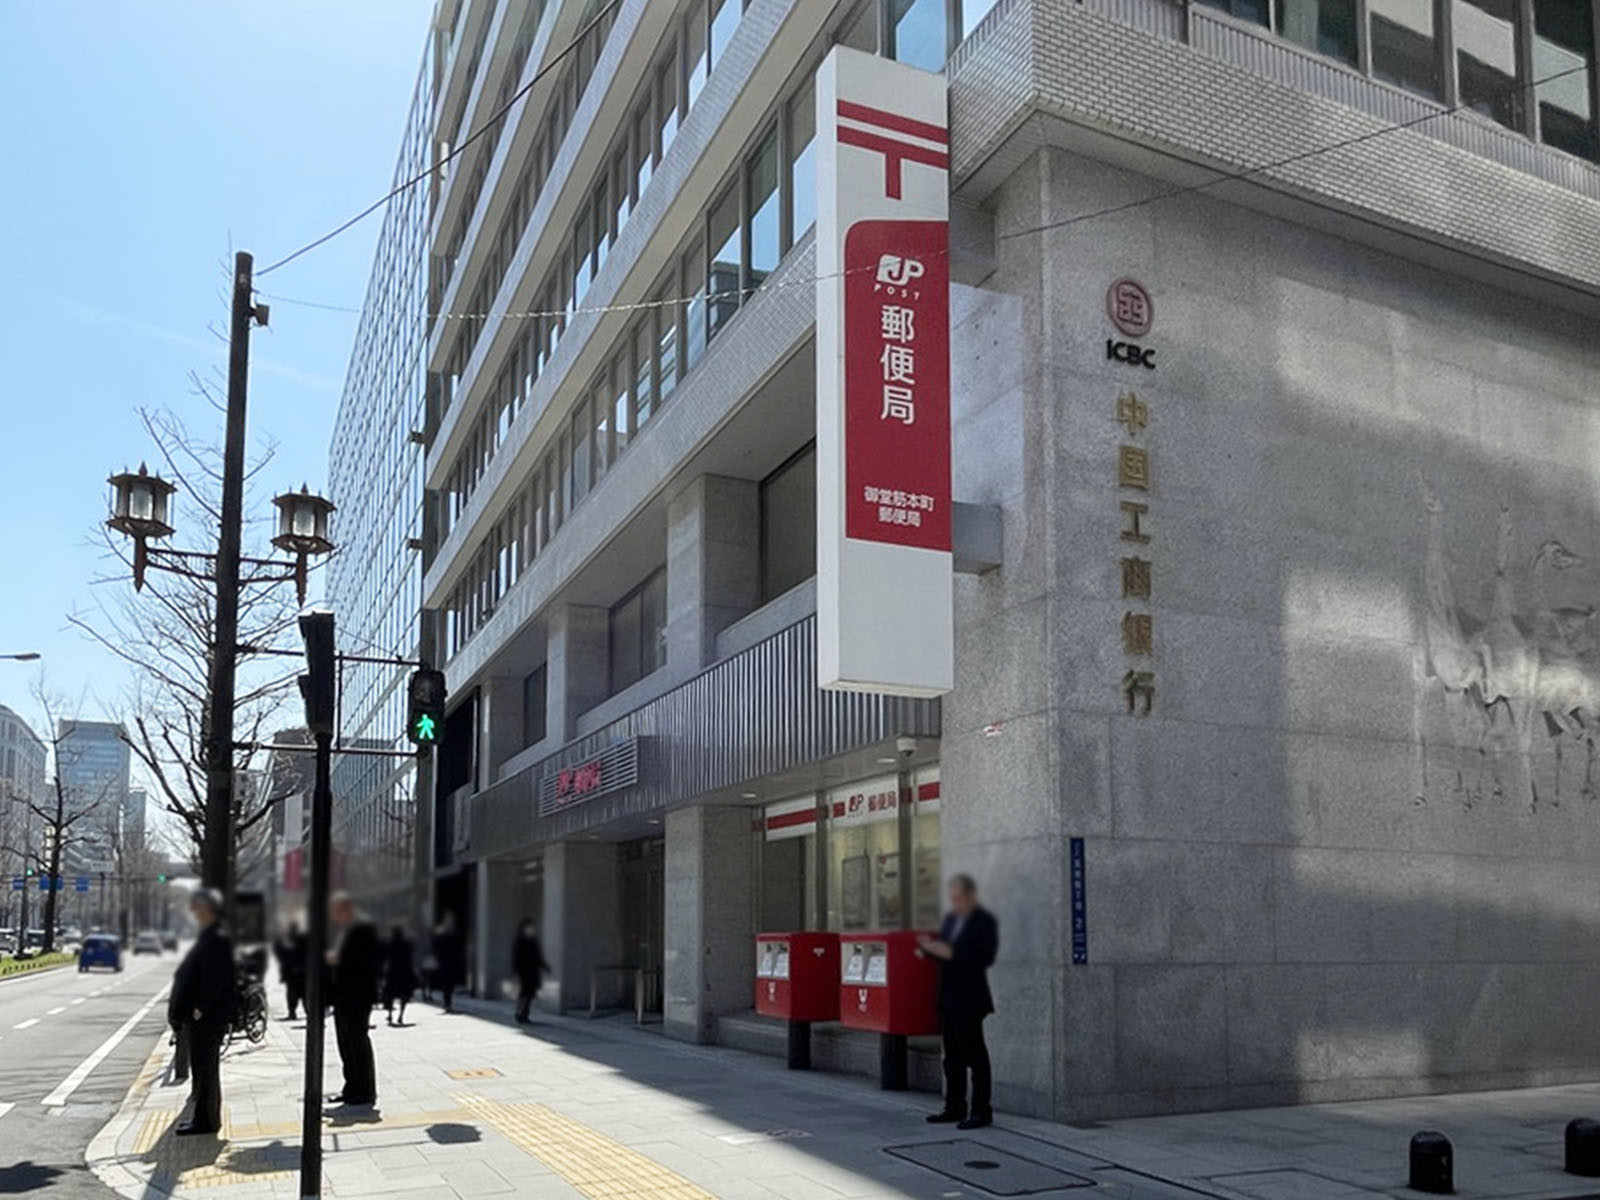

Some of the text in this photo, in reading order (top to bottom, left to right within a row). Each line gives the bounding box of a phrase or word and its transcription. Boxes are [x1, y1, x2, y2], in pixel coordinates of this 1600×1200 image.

[874, 283, 921, 301] POST
[880, 304, 916, 425] 郵便局
[1106, 338, 1156, 371] ICBC
